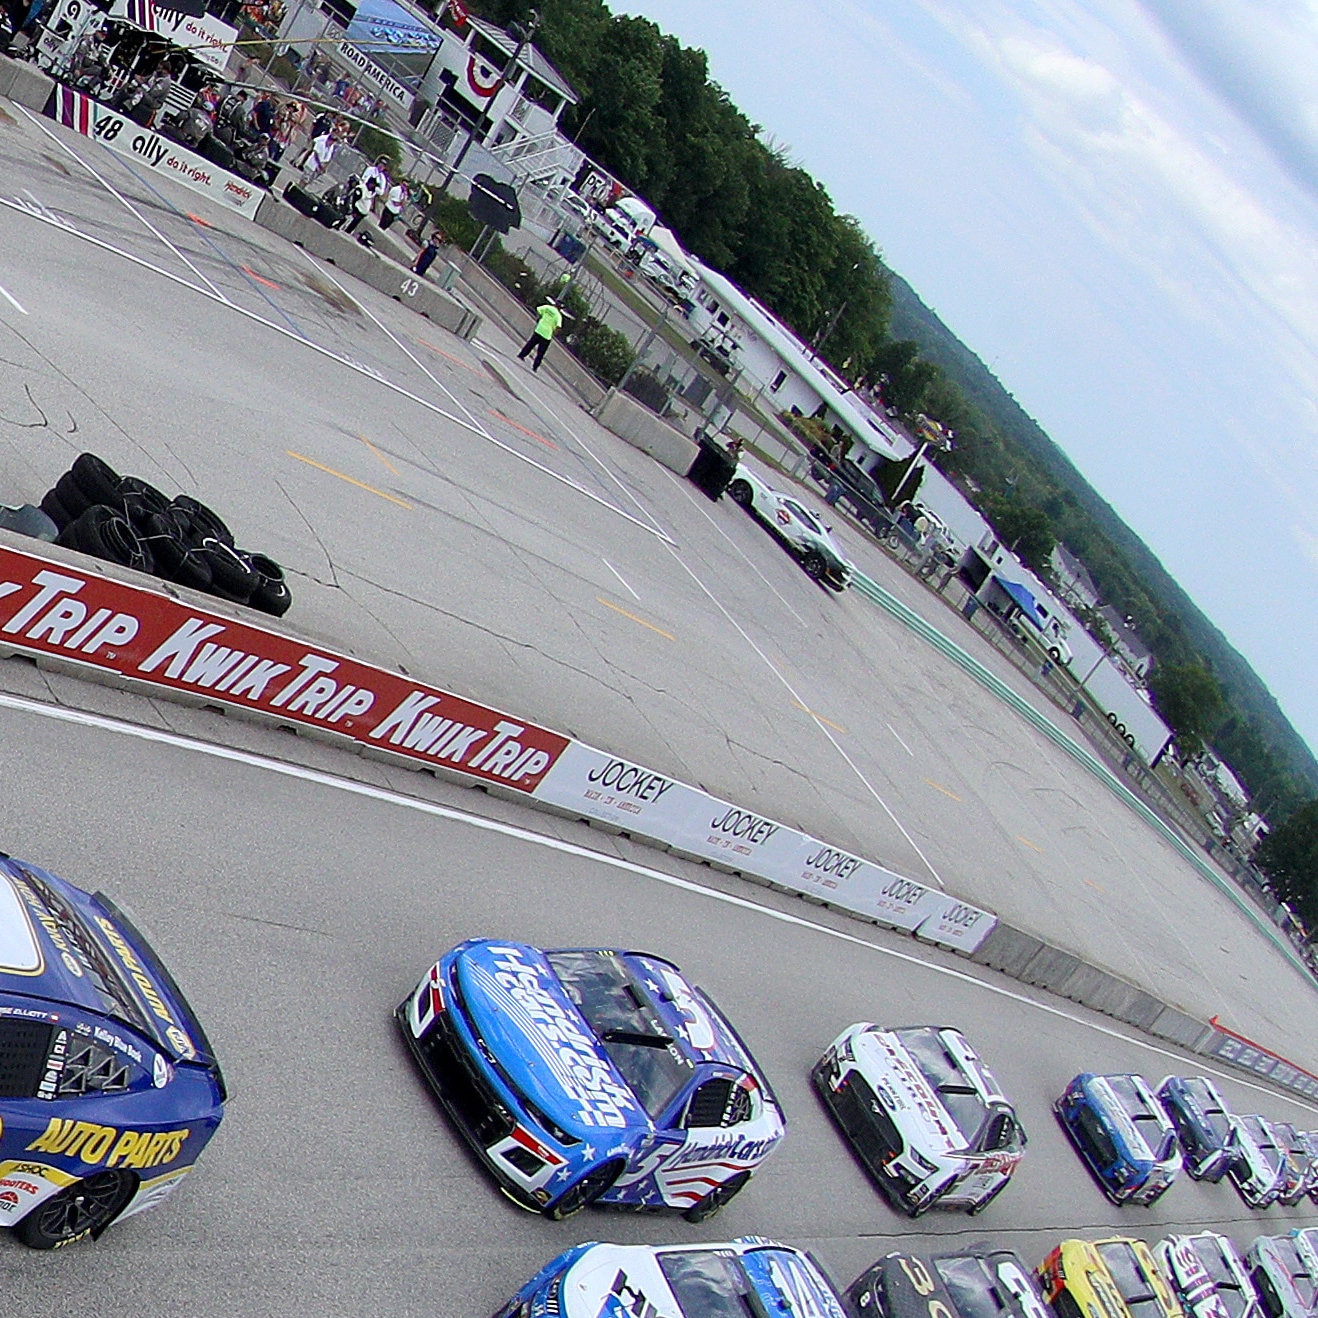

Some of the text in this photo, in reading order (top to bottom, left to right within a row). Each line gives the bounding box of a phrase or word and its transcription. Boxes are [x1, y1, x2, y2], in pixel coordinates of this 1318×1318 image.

[340, 41, 405, 101] ROAD AMERICA
[94, 115, 123, 141] 48
[131, 134, 169, 167] ally
[167, 156, 178, 169] do
[180, 160, 189, 175] it
[400, 278, 419, 297] 43
[588, 757, 675, 804] JOCKEY
[711, 808, 781, 846] JOCKEY
[806, 849, 863, 880] JOCKEY
[881, 877, 929, 905] JOCKEY
[25, 1116, 190, 1169] AUTO PARTS
[859, 1290, 872, 1307] 8
